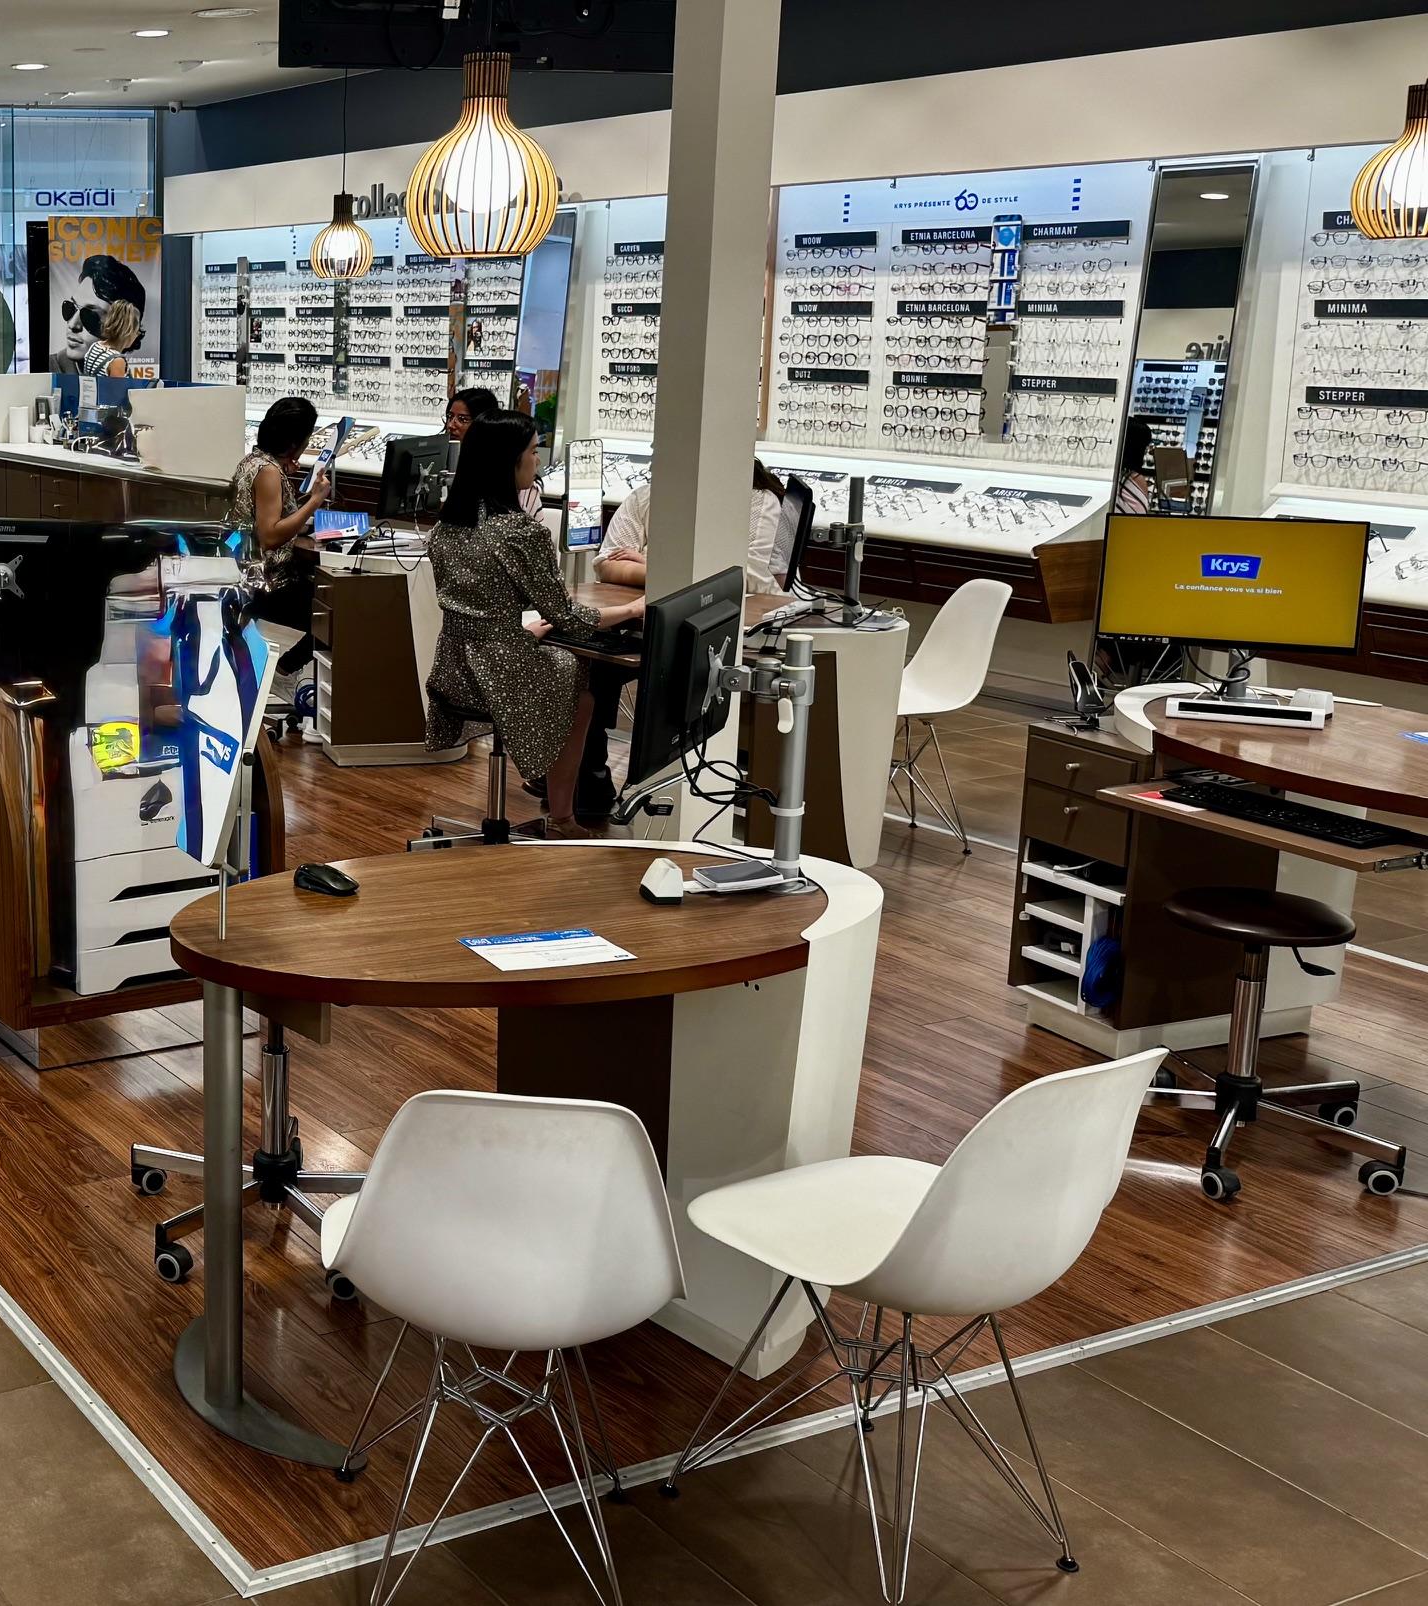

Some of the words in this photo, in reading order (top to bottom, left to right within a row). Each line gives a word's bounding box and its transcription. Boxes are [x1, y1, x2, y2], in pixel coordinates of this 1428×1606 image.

[36, 188, 115, 207] okaïdi
[914, 200, 951, 208] PRÉSENTE
[49, 217, 163, 241] ICONIC
[1033, 226, 1078, 237] CHARMANT
[802, 236, 822, 245] WOOW
[910, 231, 931, 241] ETNIA
[933, 230, 976, 240] BARCELONA
[50, 240, 161, 263] SUMMER
[798, 304, 818, 312] WOOW
[905, 304, 926, 312] ETNIA
[928, 304, 970, 312] BARCELONA
[1027, 304, 1058, 313] MINIMA
[1327, 303, 1368, 313] MINIMA
[901, 375, 928, 384] BONNIE
[1021, 378, 1057, 388] STEPPER
[1318, 390, 1365, 401] STEPPER
[875, 476, 908, 487] MARITZA
[992, 488, 1027, 499] ARISTAR
[1210, 558, 1250, 574] Krys
[1186, 584, 1223, 592] confiance
